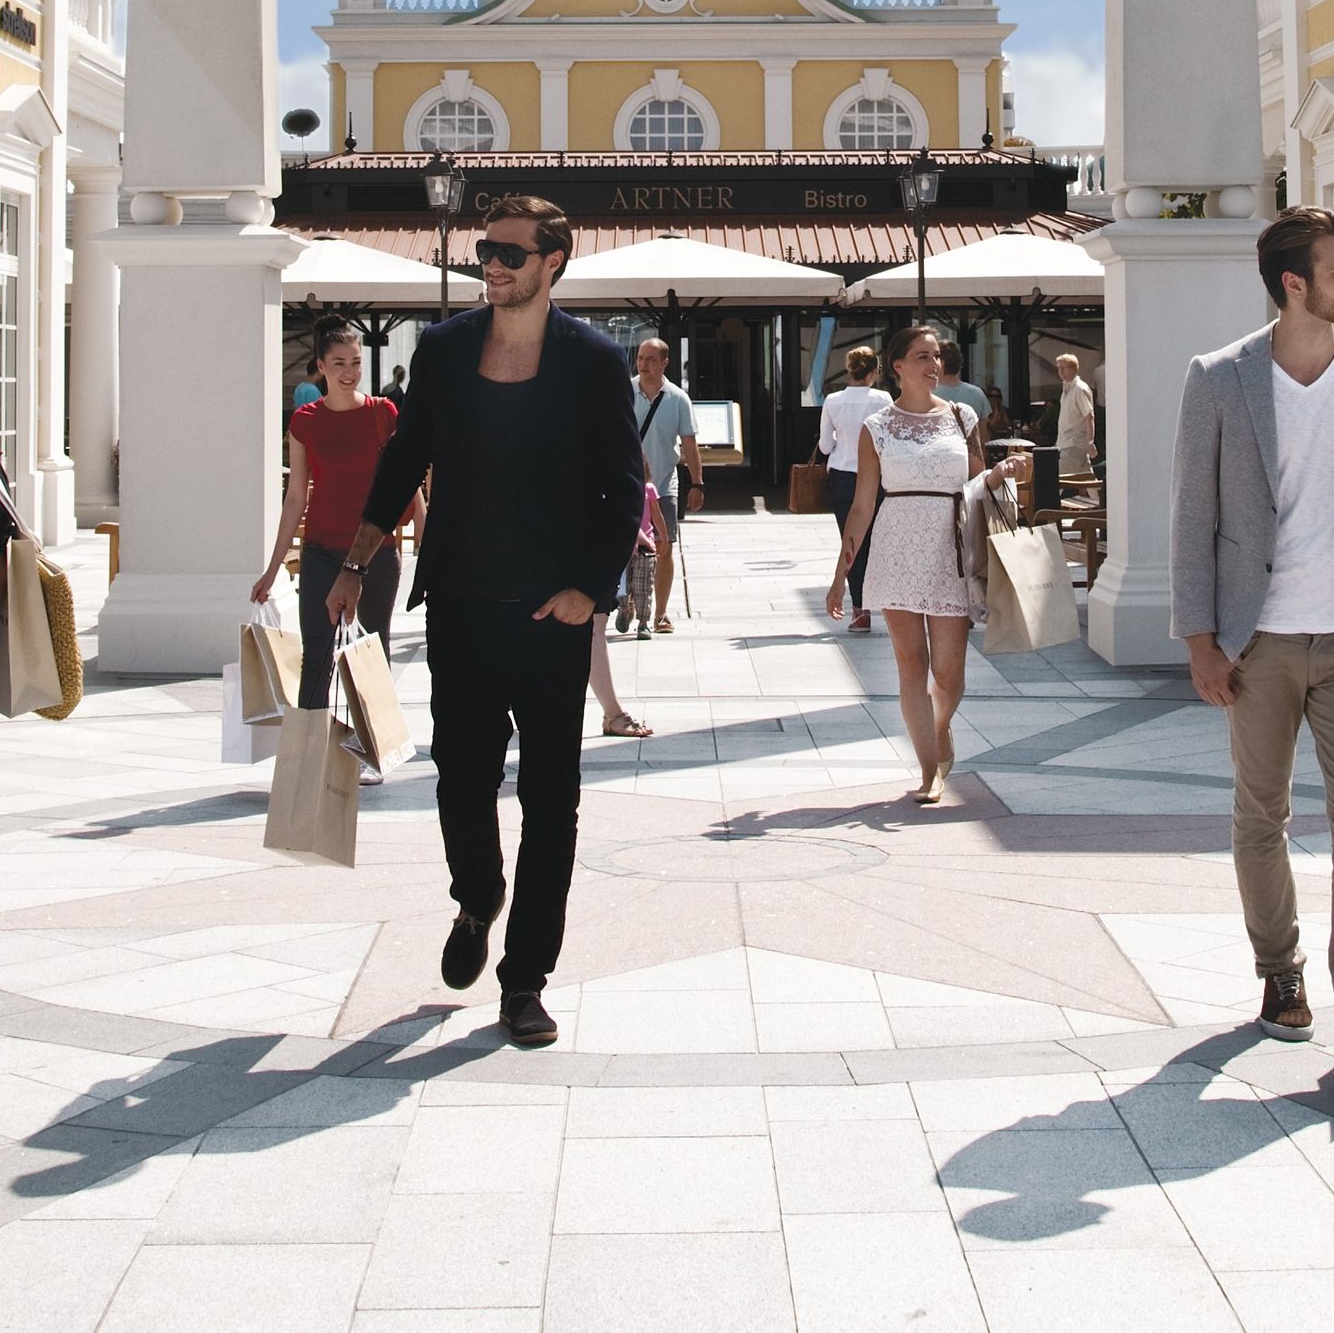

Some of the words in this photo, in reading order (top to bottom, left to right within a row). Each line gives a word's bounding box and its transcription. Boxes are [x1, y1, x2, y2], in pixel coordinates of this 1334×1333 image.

[475, 191, 521, 212] Ca
[609, 186, 734, 210] ARTNER
[804, 189, 868, 209] Bistro
